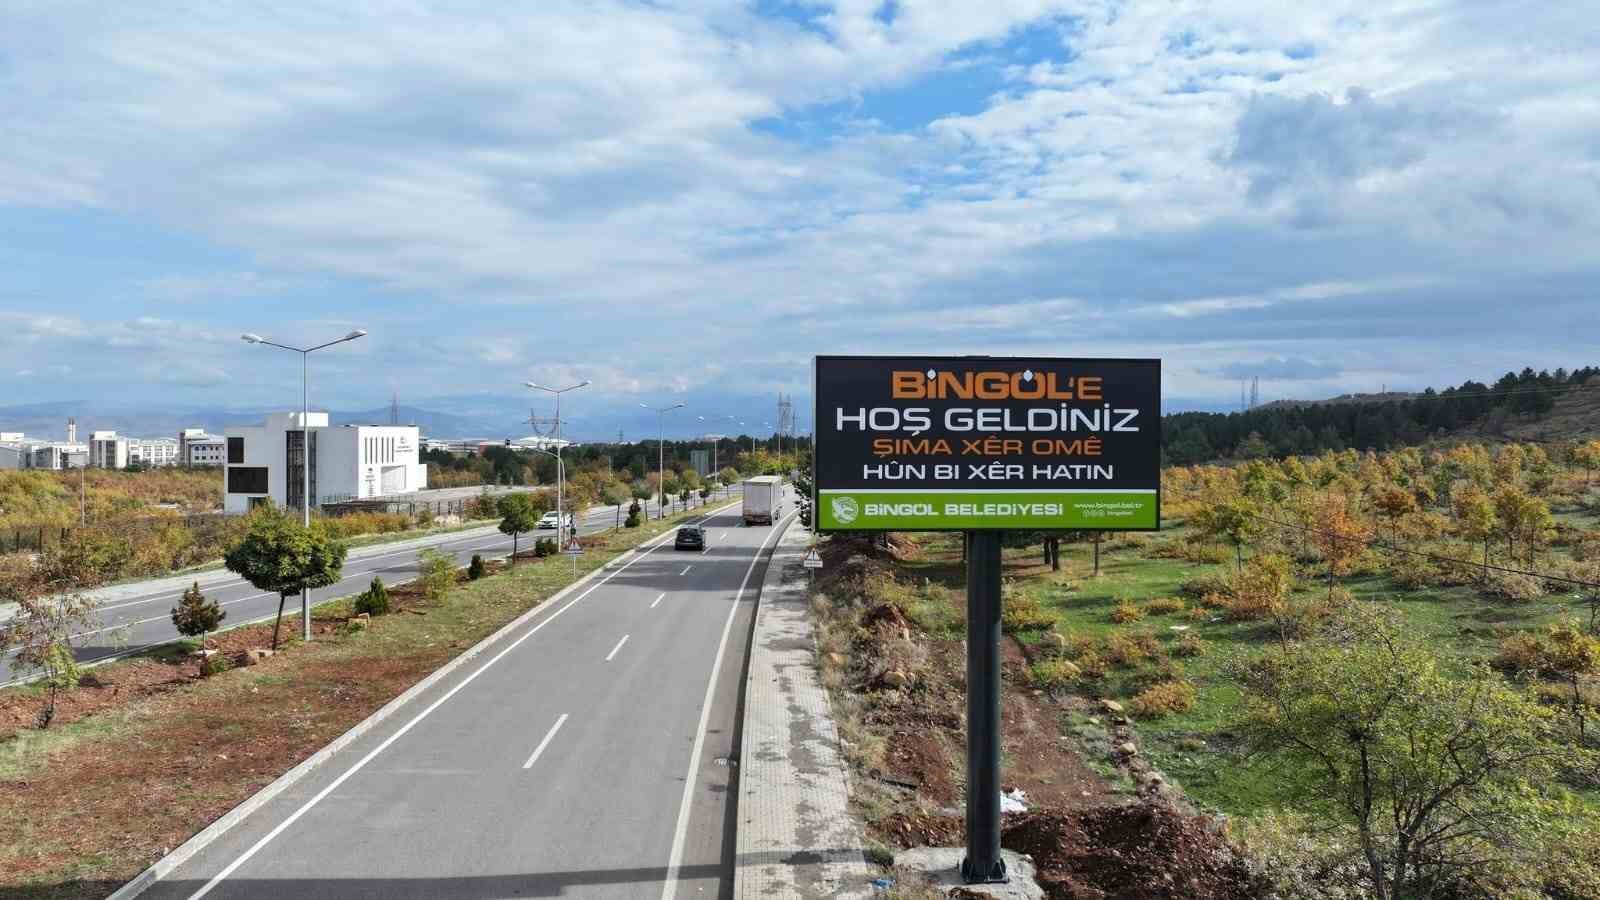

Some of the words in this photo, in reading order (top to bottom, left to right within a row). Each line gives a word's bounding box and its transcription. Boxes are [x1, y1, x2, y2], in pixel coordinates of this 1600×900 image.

[836, 407, 931, 436] HOŞ
[945, 402, 1140, 432] GELDİNİZ
[872, 439, 953, 459] ŞIMA
[962, 435, 1023, 456] XÊR
[1032, 435, 1103, 456] OMÊ
[863, 460, 925, 480] HÛN
[935, 464, 960, 480] BI
[968, 460, 1024, 480] XÊR
[1032, 464, 1114, 480] HATIN
[864, 502, 939, 517] BİNGÖL
[945, 502, 1064, 517] BELEDİYESİ
